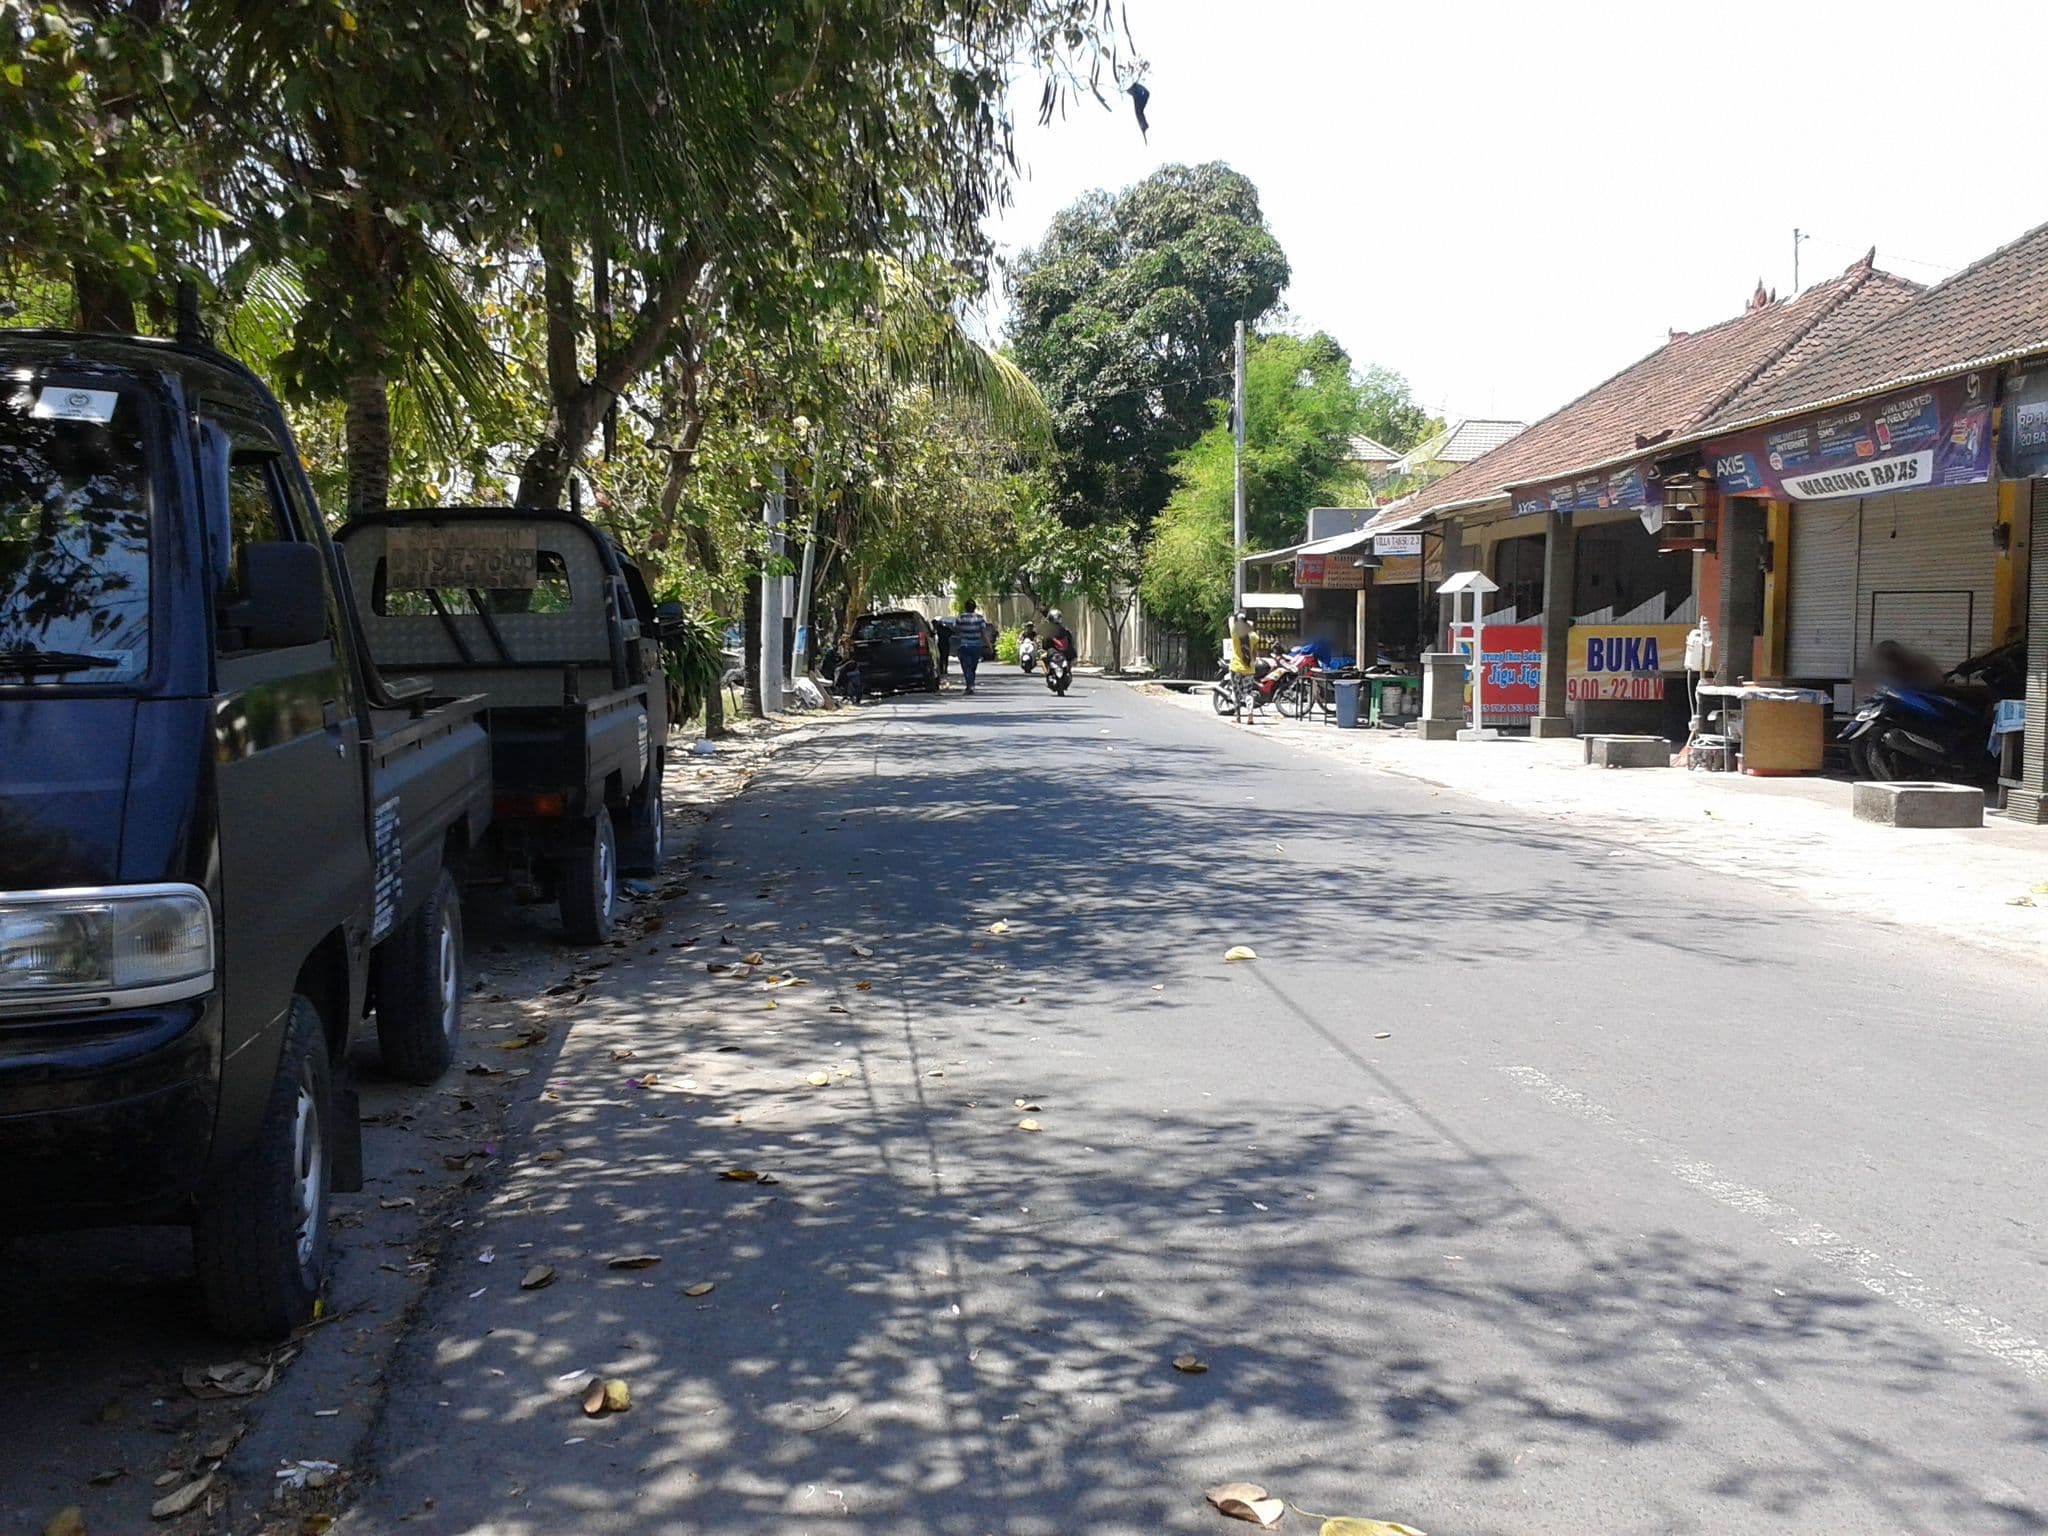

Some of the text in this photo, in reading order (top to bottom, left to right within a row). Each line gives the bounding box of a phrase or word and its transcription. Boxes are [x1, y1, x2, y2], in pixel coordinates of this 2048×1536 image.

[1881, 394, 1932, 416] UNLIMITED
[1716, 454, 1745, 478] AXIS
[1796, 470, 1870, 496] WARUNG
[1587, 637, 1659, 672] BUKA
[1488, 664, 1516, 688] Jigu
[1568, 679, 1599, 701] 9.00
[1611, 678, 1650, 699] 22.00
